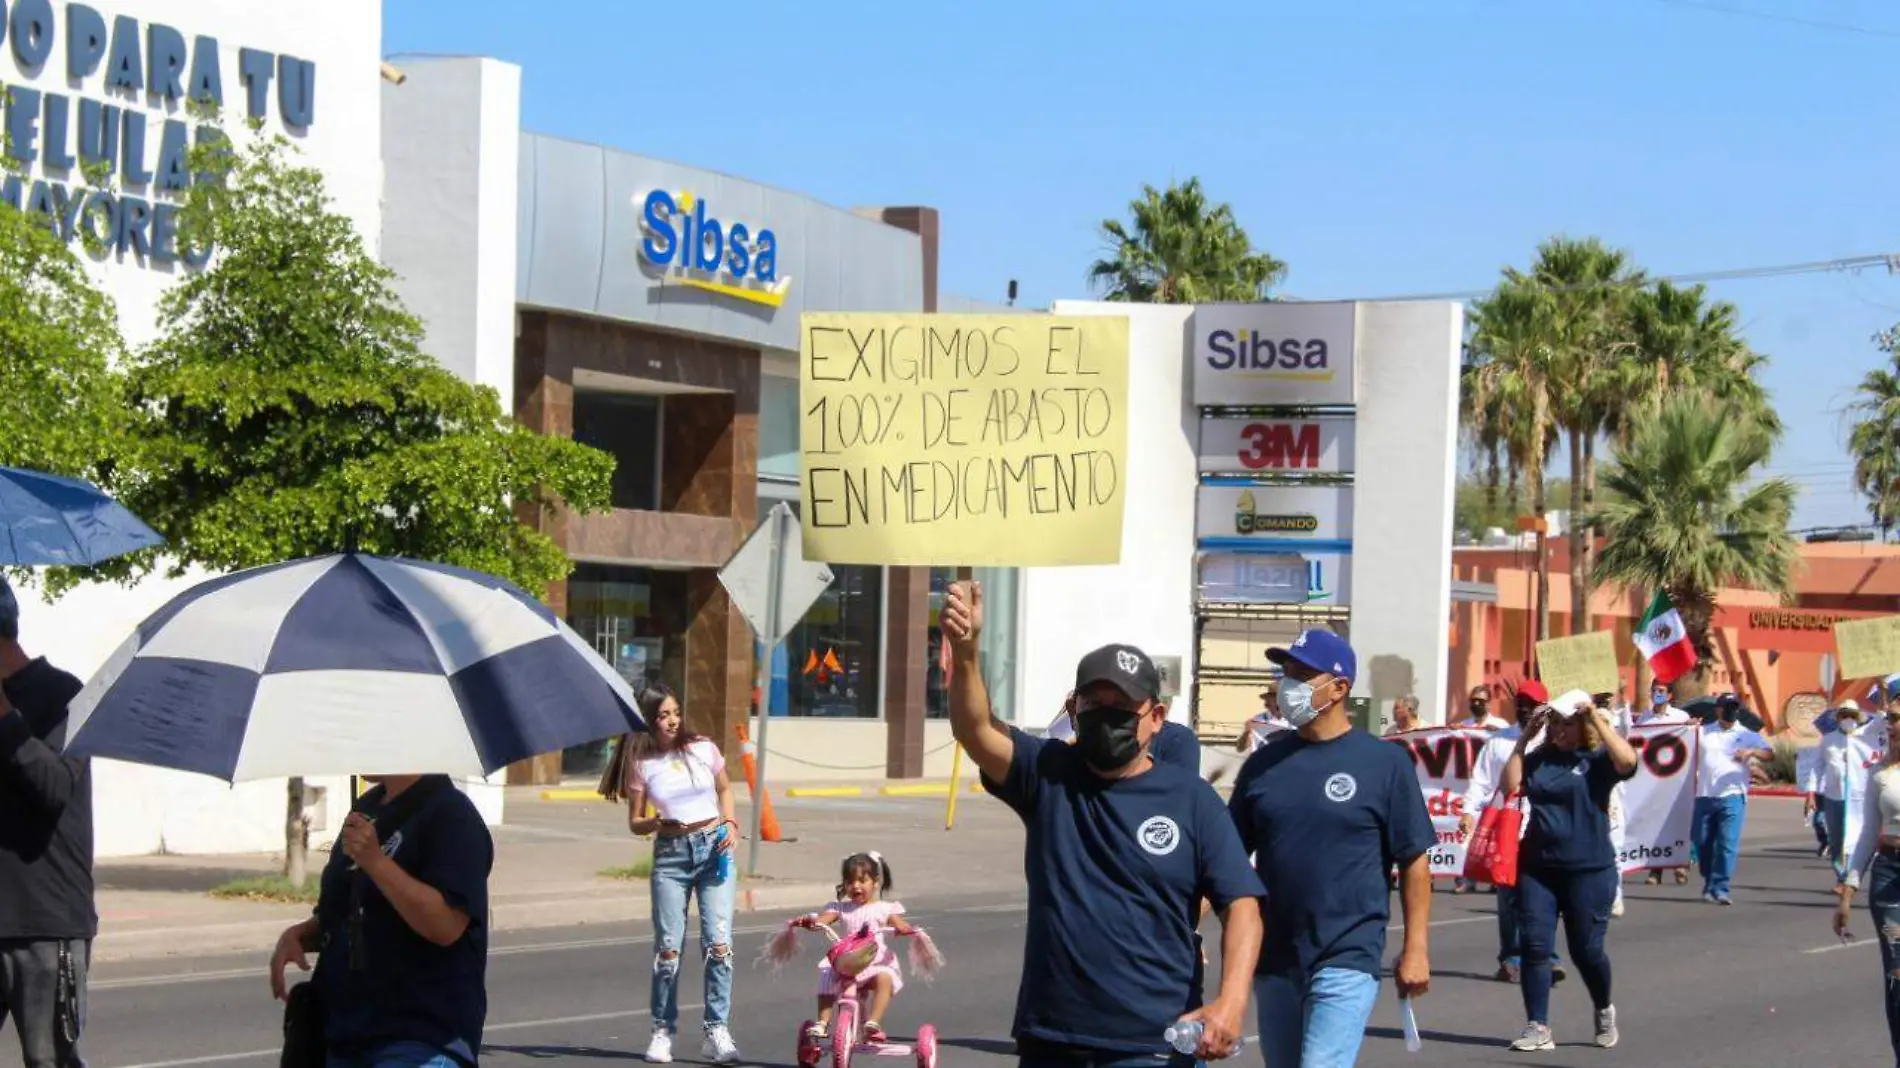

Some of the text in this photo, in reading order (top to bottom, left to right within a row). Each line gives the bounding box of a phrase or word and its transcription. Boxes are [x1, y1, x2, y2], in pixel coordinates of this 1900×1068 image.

[0, 0, 315, 129] O PARA TU
[0, 84, 234, 194] ELULAR
[644, 189, 777, 282] Sibsa
[810, 325, 1100, 385] EXIGIMOS EL
[1207, 329, 1328, 369] Sibsa
[805, 386, 1111, 454] 100% DE ABASTO
[1238, 424, 1320, 468] 3M
[809, 450, 1117, 528] EN MEDICAMENTO
[1239, 516, 1316, 530] COMANDO
